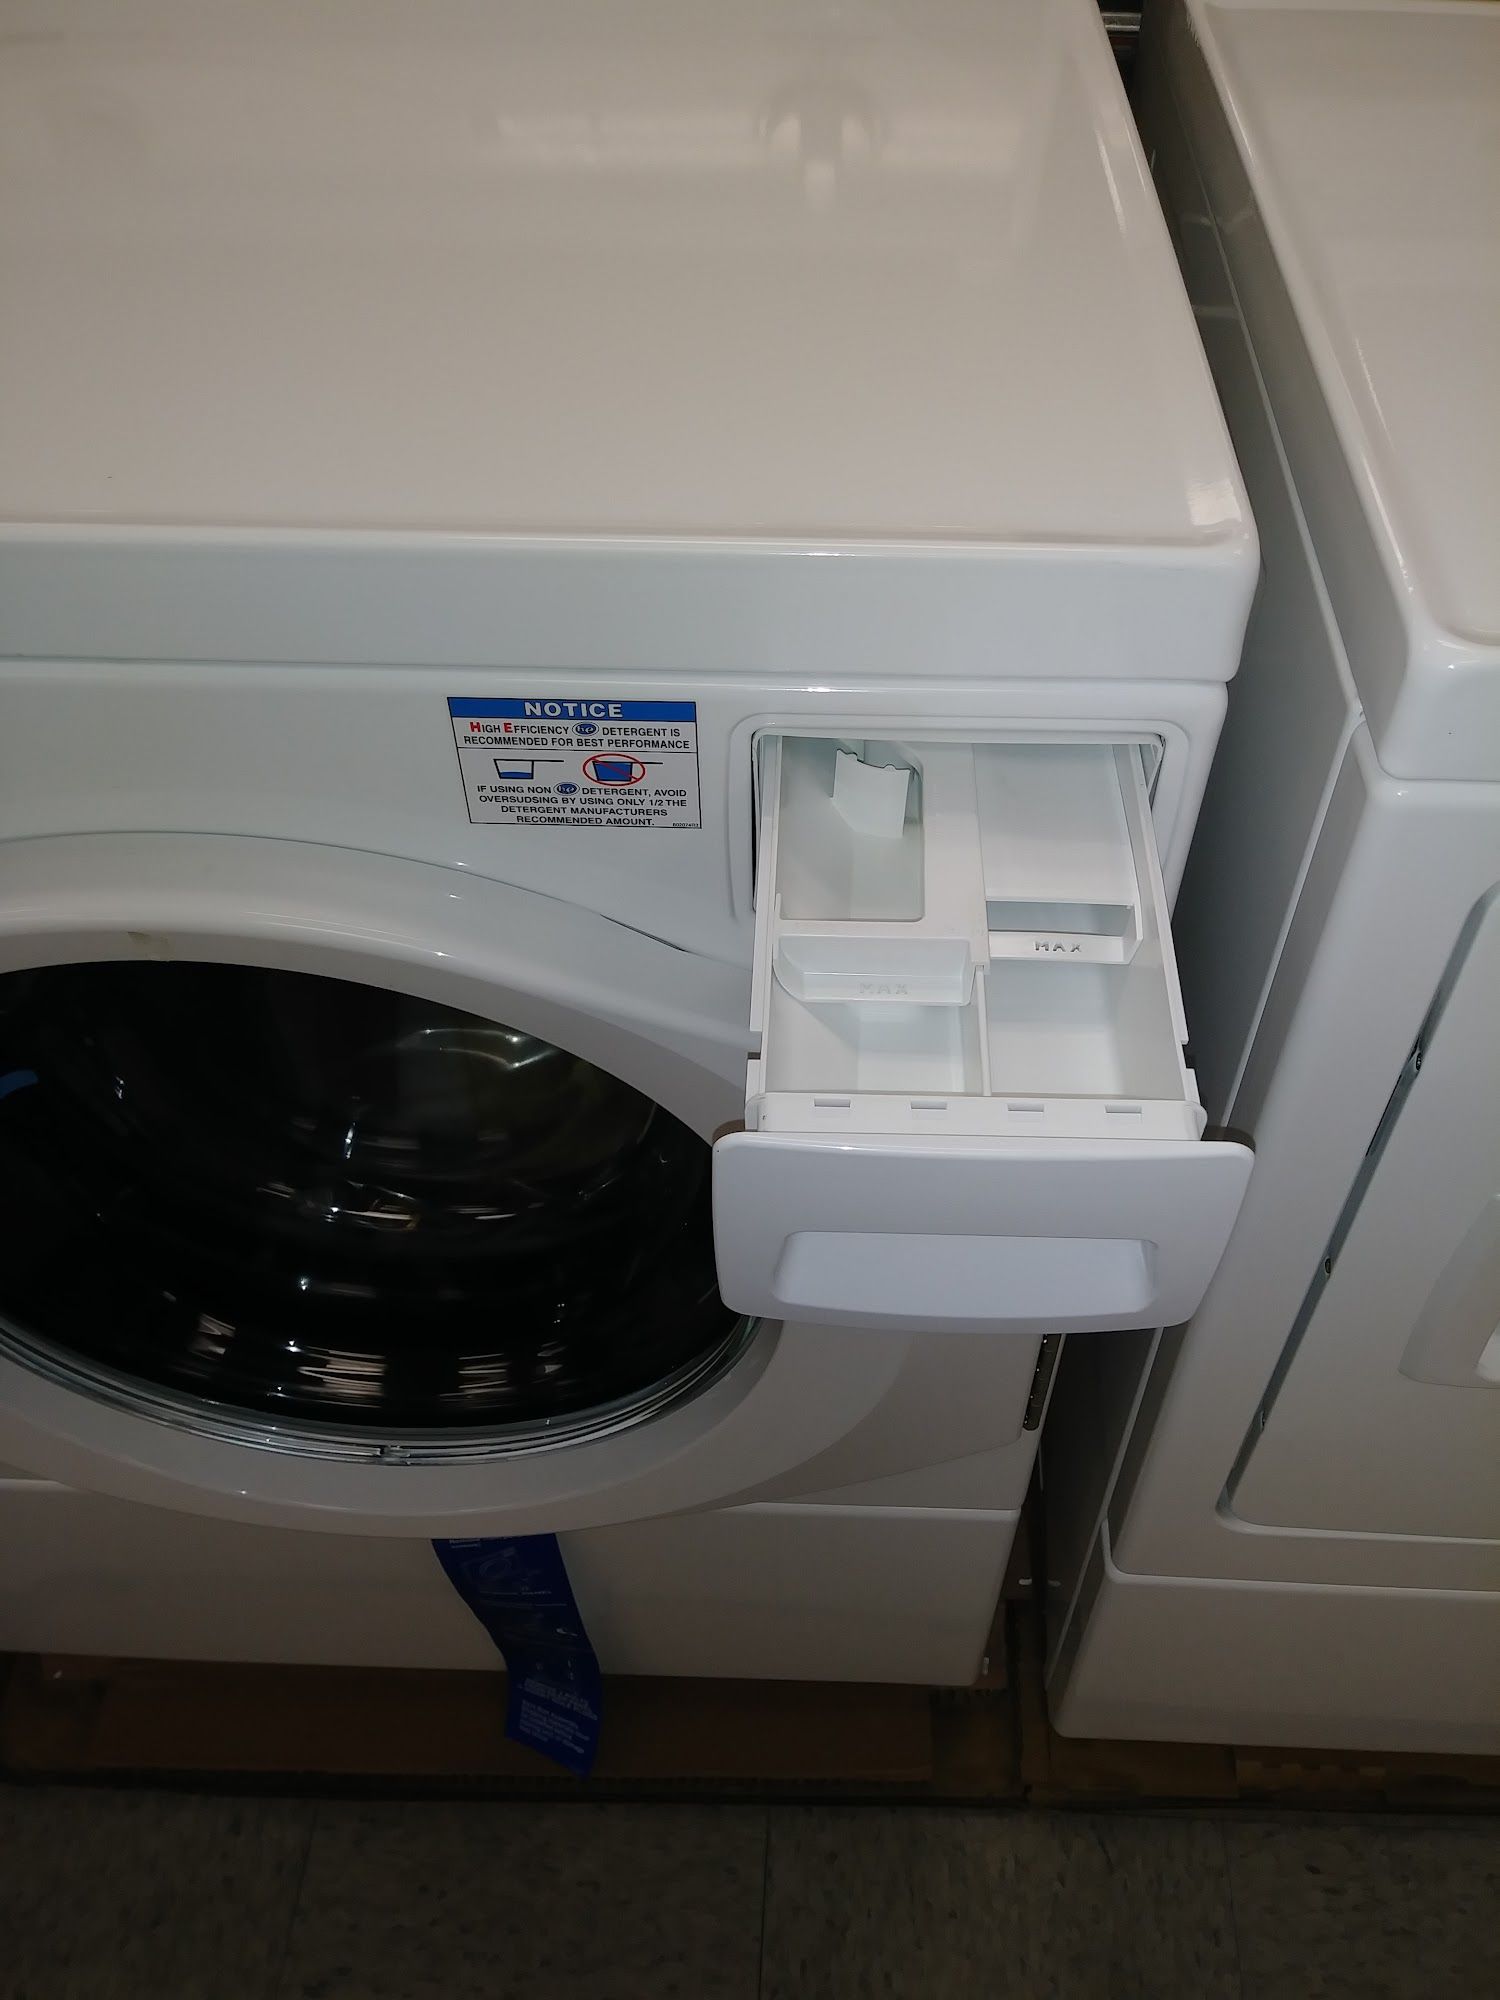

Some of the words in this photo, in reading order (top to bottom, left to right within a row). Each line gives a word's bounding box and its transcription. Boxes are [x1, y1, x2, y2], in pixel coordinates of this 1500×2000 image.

[524, 702, 623, 718] NOTICE
[470, 721, 501, 734] HIGH
[503, 722, 569, 735] EFFICIENCY
[602, 727, 667, 737] DETERGENT
[670, 728, 681, 737] IS
[463, 735, 548, 746] RECOMMENDED
[551, 738, 573, 747] FOR
[577, 738, 604, 747] BEST
[607, 739, 690, 749] PERFORMANCE
[477, 785, 487, 793] IF
[490, 785, 524, 794] USING
[527, 786, 552, 794] NON
[582, 787, 651, 797] DETERGENT,
[654, 789, 687, 797] AVOID
[479, 795, 559, 804] OVERSUDSING
[562, 797, 576, 805] BY
[579, 797, 614, 806] USING
[617, 798, 645, 806] ONLY
[649, 799, 664, 807] 1/2
[665, 799, 687, 807] THE
[501, 805, 567, 814] DETERGENT
[570, 807, 668, 817] MANUFACTURERS
[516, 815, 603, 825] RECOMMENDED
[605, 817, 655, 826] AMOUNT.
[1034, 941, 1082, 953] MAX
[859, 982, 908, 995] MAX
